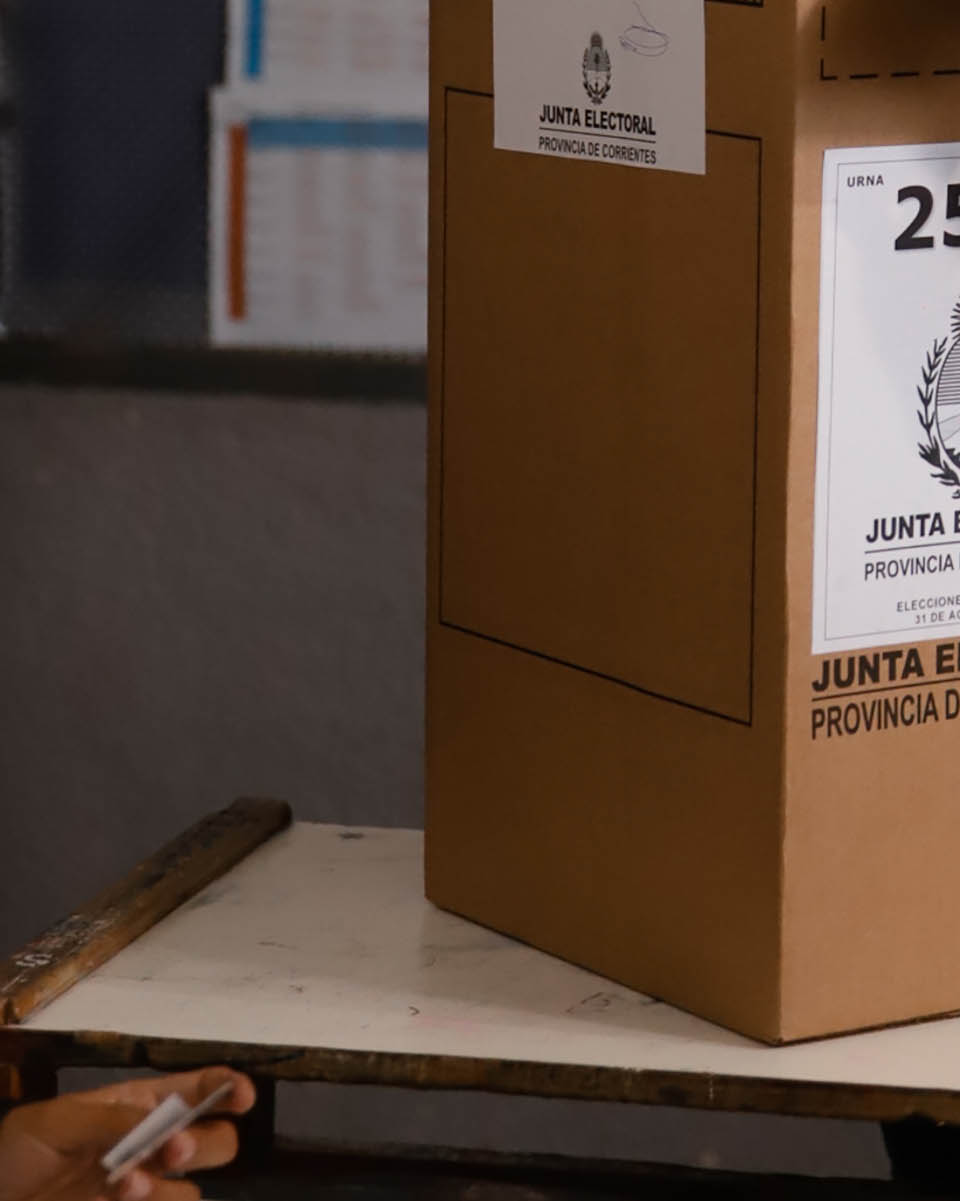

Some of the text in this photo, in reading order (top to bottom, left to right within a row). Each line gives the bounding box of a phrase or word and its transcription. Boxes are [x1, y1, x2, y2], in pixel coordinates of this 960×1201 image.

[540, 104, 657, 136] JUNTA ELECTORAL
[538, 136, 657, 165] PROVINCIA DE CORRIENTES
[846, 173, 885, 188] URNA
[865, 511, 945, 544] JUNTA
[864, 554, 954, 581] PROVINCIA
[914, 613, 927, 625] 31
[930, 611, 945, 623] DE
[811, 648, 924, 692] JUNTA
[811, 691, 939, 740] PROVINCIA
